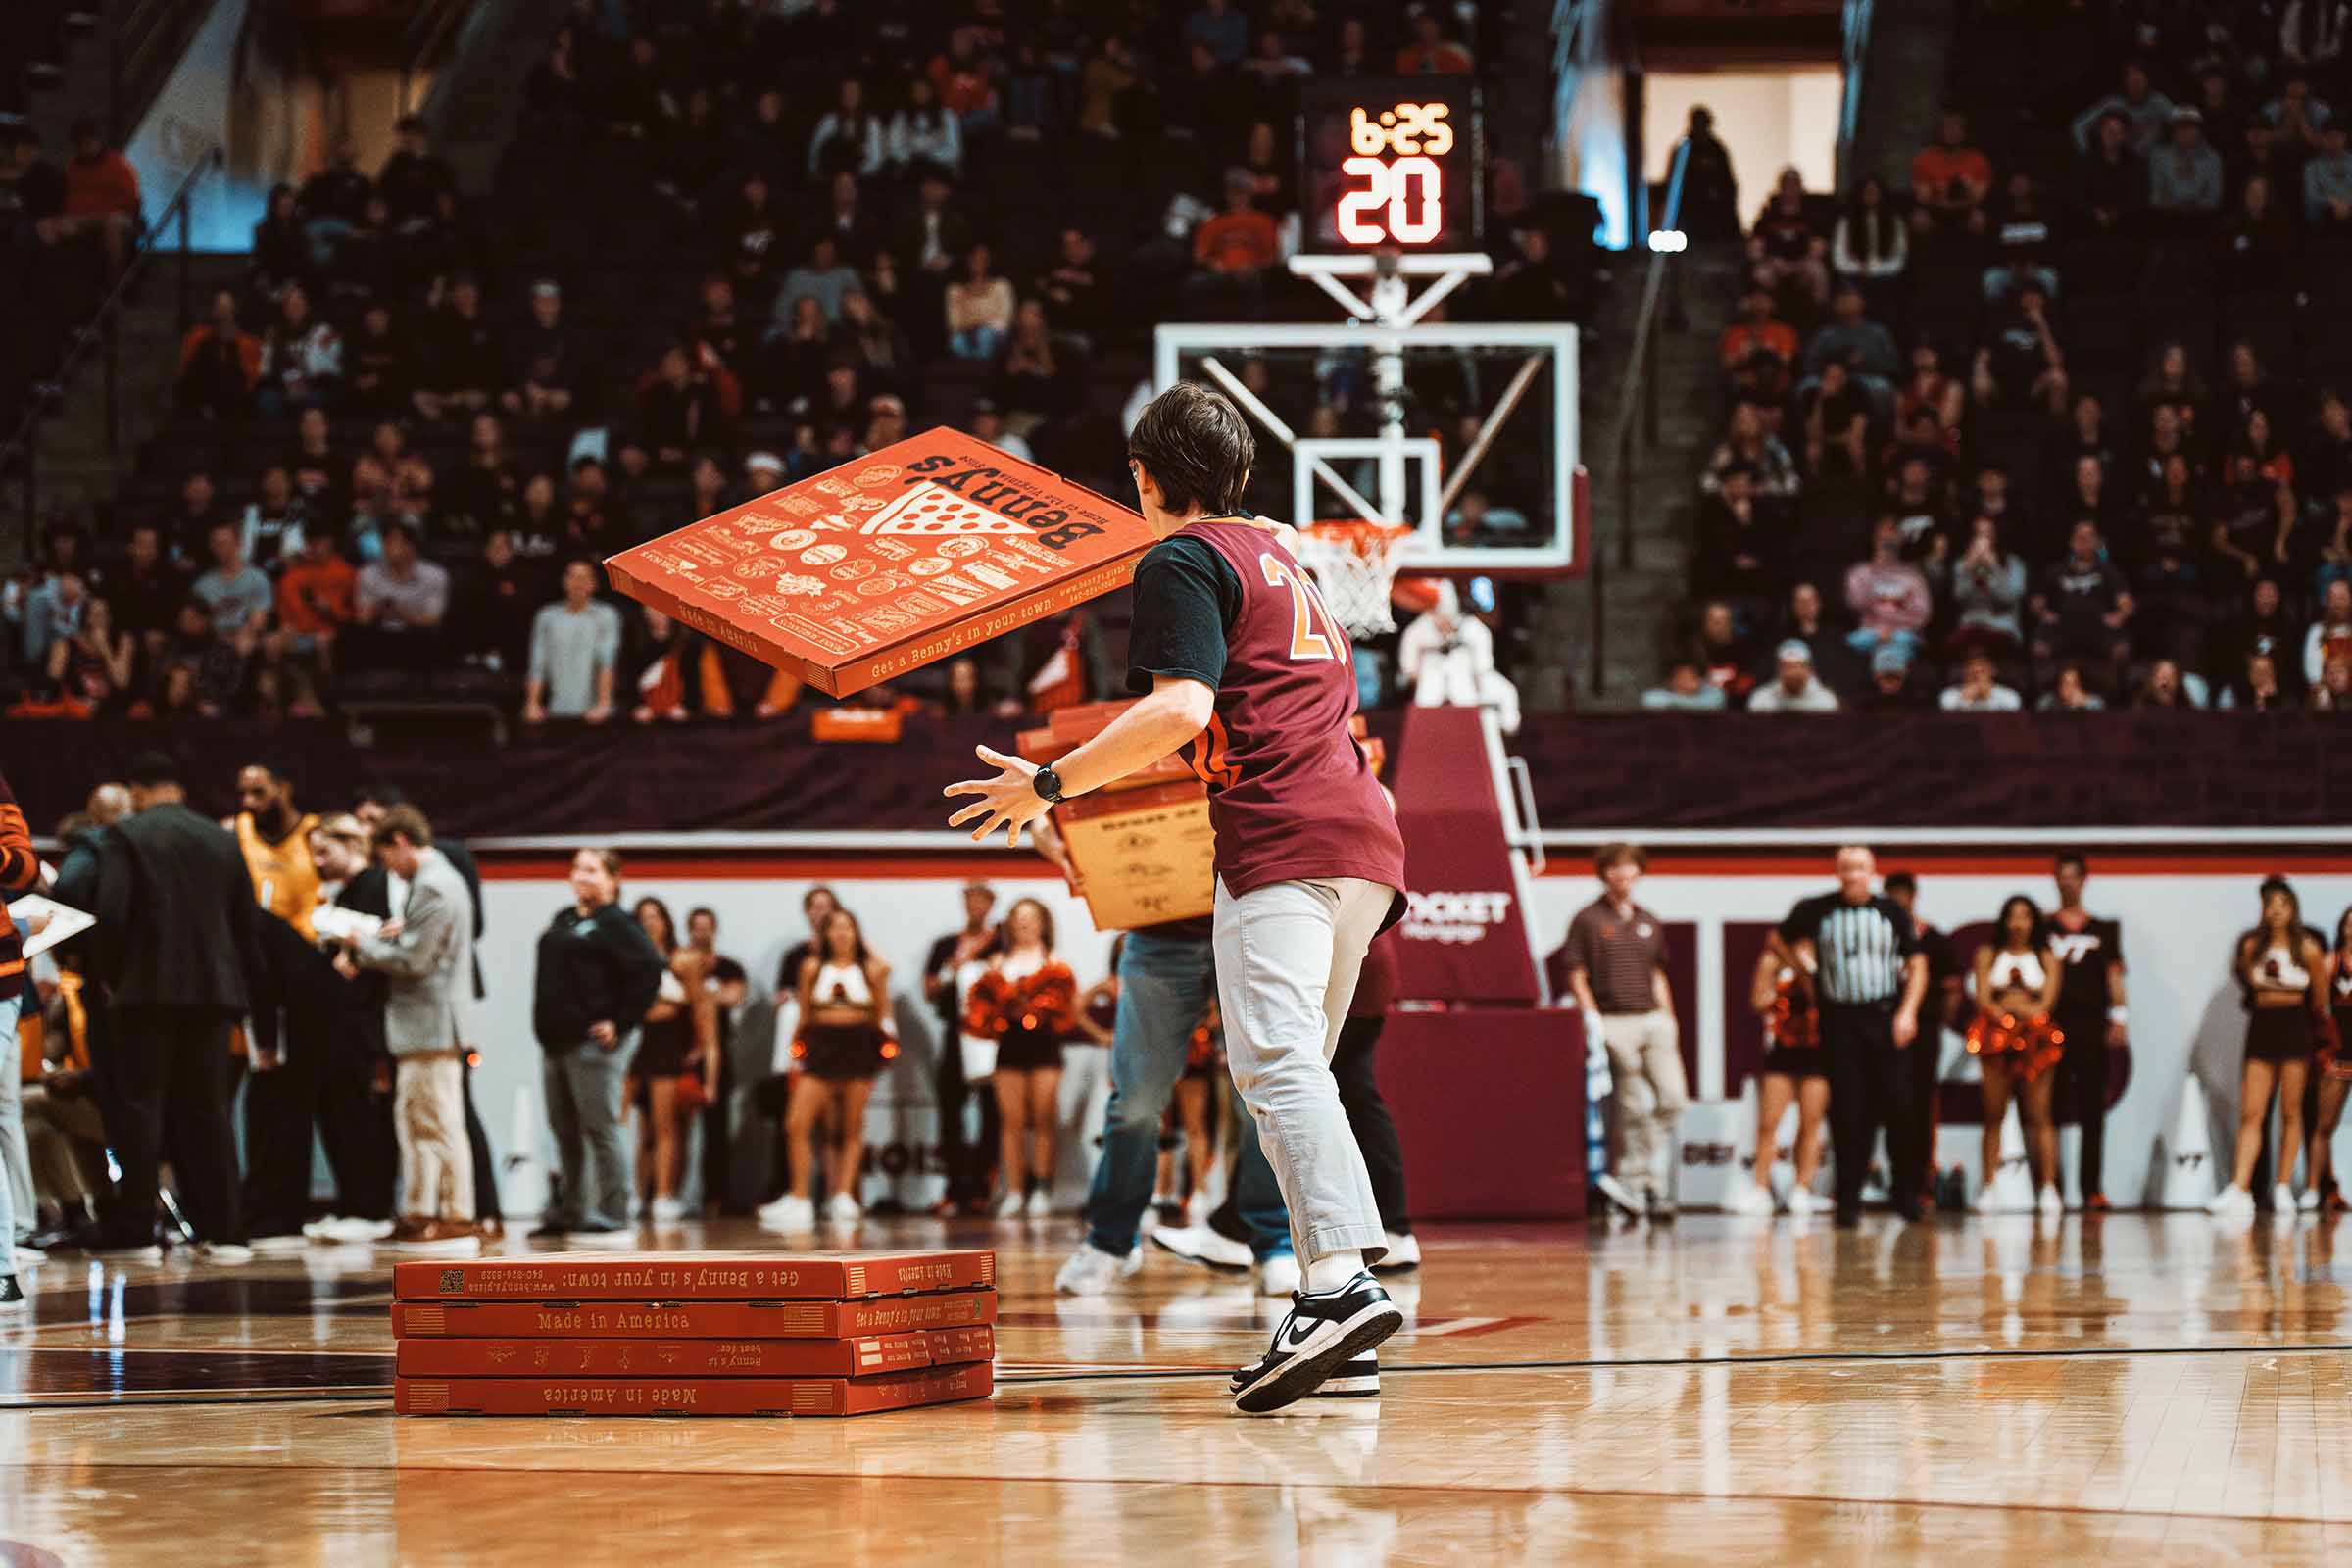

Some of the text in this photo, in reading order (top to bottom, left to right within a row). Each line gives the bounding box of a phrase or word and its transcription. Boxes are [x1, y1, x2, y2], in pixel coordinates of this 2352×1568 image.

[1350, 102, 1454, 157] 6:25
[1338, 156, 1442, 245] 20
[903, 455, 1106, 550] Benny's
[871, 596, 1056, 679] Get a Benny's in your town:
[562, 1267, 800, 1293] Get a Benny's in your town:
[538, 1312, 690, 1330] Made in America
[720, 1355, 761, 1367] Benny's
[543, 1387, 698, 1405] Made in America
